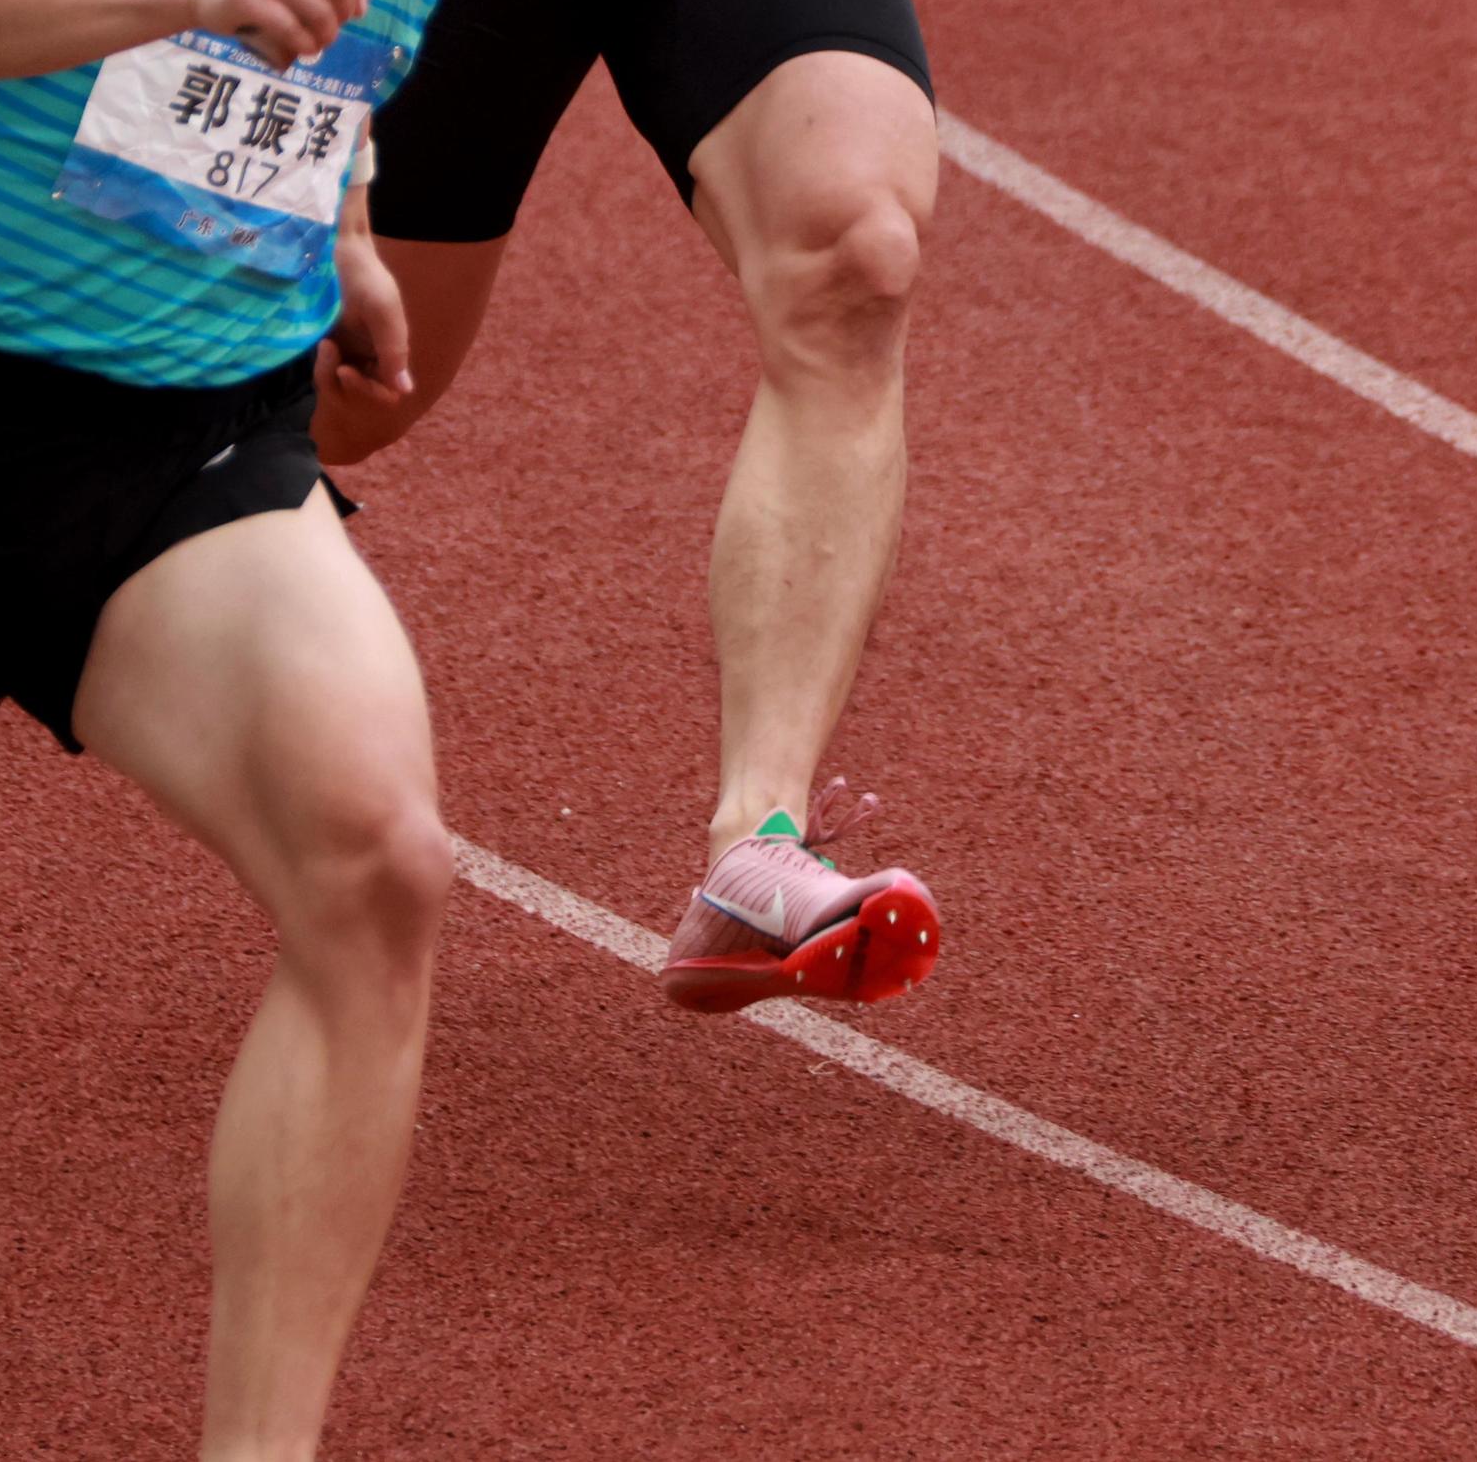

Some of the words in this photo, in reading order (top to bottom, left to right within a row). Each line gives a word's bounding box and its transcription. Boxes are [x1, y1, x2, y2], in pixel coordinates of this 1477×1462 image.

[169, 61, 345, 167] 郭振泽
[206, 150, 280, 199] 817
